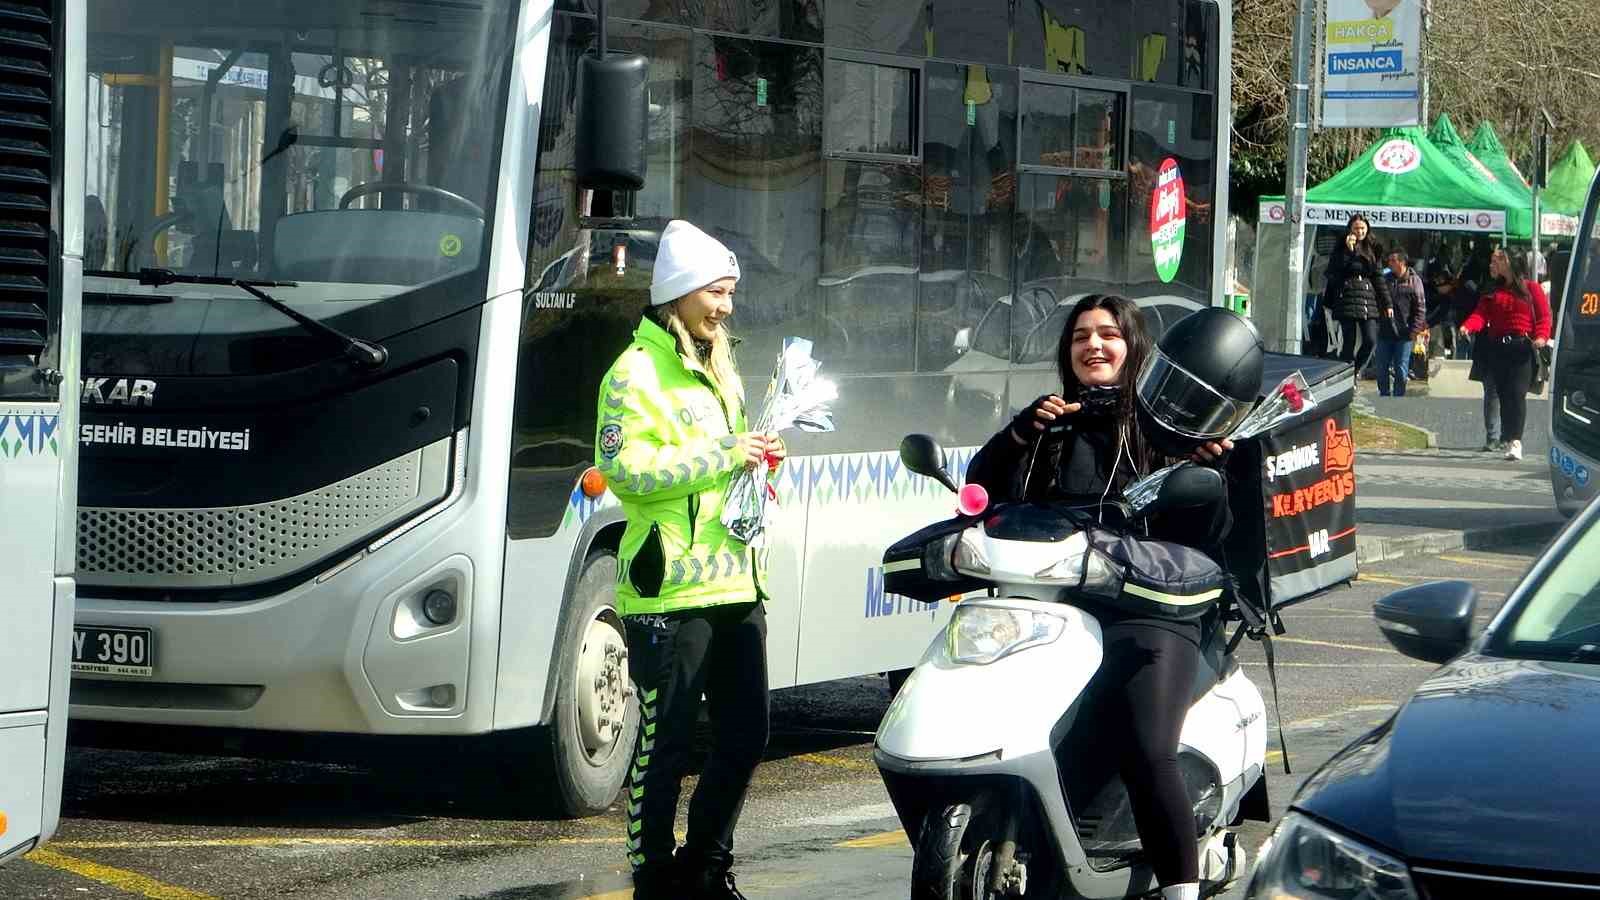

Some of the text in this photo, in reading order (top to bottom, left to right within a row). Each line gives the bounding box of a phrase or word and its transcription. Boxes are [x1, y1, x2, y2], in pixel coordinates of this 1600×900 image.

[1335, 24, 1388, 40] HAKÇA
[1333, 55, 1395, 72] İNSANCA
[1391, 210, 1470, 225] BELEDİYESİ
[535, 292, 577, 310] SULTAN LF
[1581, 293, 1599, 315] 20
[142, 426, 249, 450] BELEDİYESİ
[97, 633, 144, 664] 390
